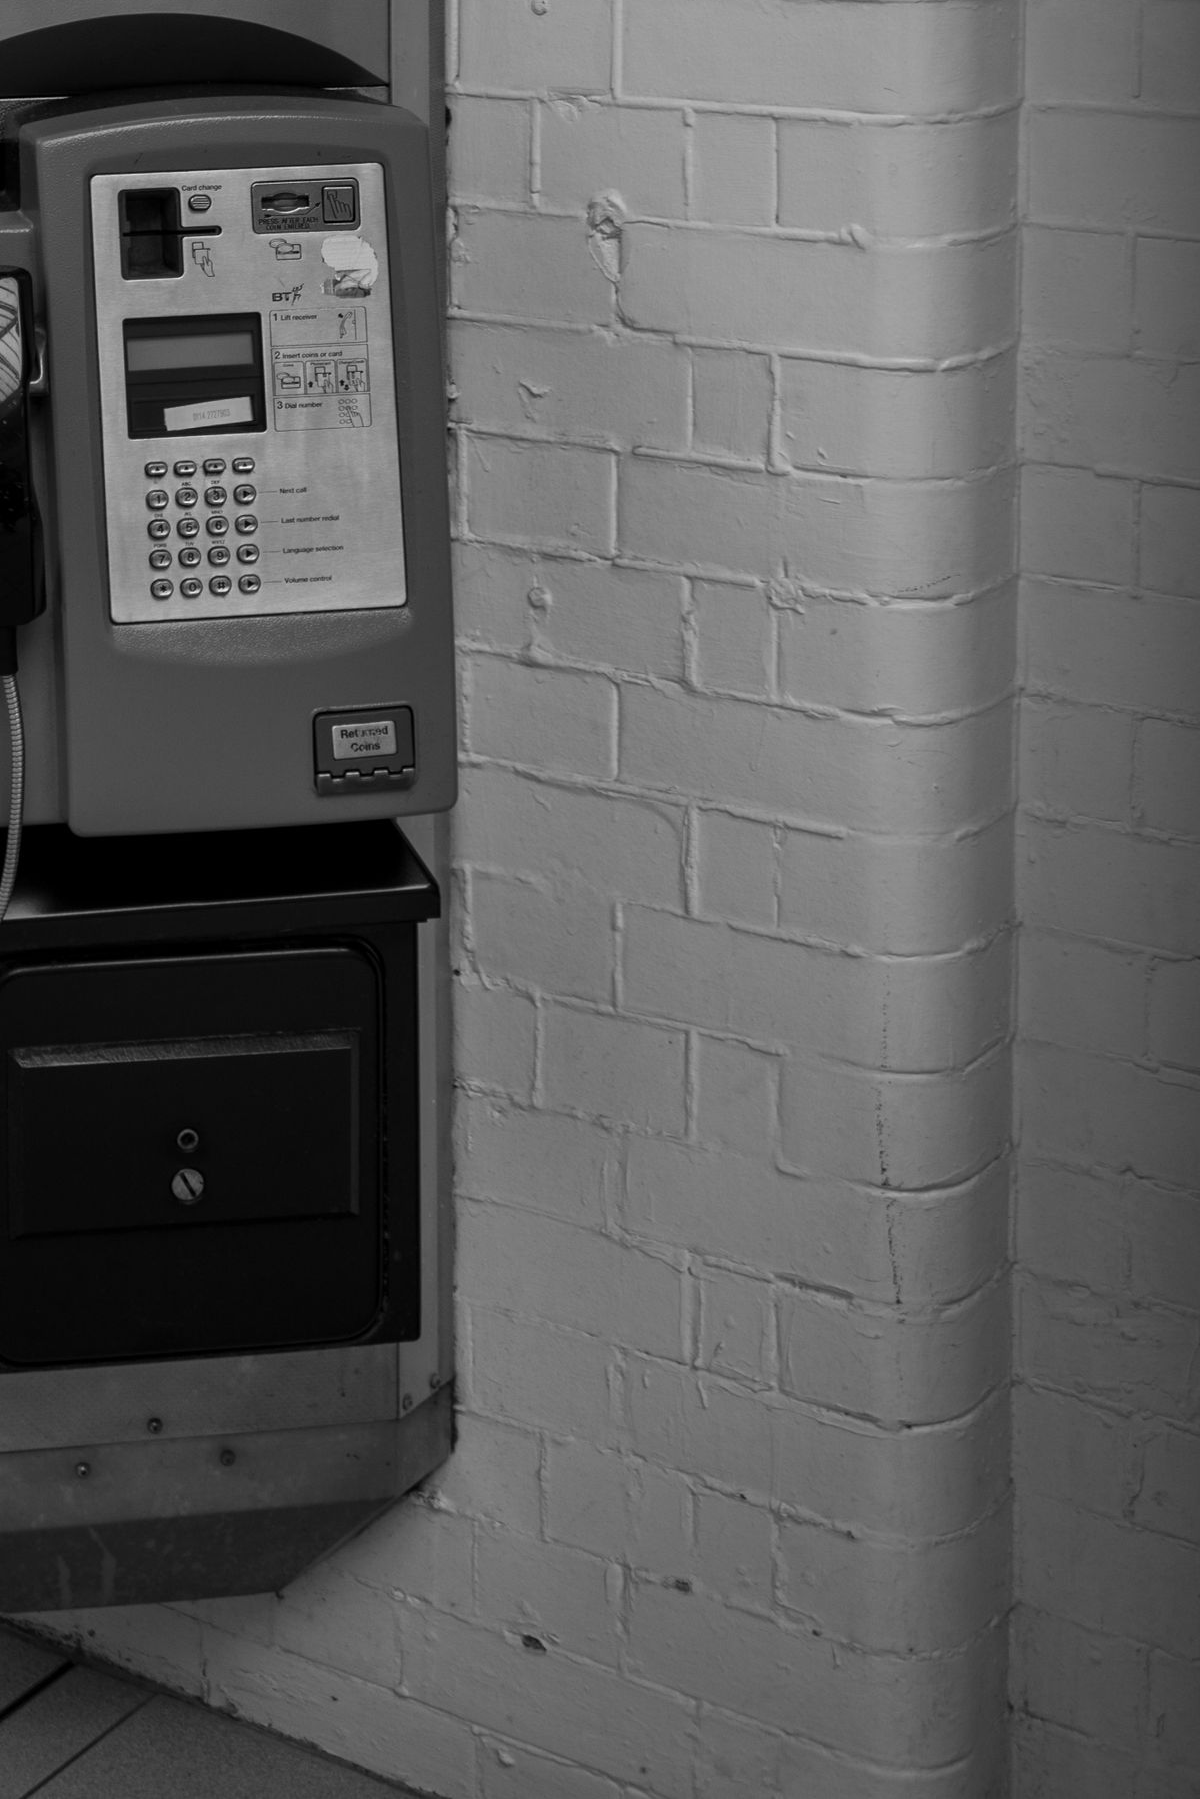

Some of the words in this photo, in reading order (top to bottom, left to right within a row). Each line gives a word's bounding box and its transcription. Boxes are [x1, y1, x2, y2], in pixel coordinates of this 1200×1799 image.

[199, 184, 222, 192] change
[272, 292, 292, 302] BT
[274, 351, 281, 359] 2
[301, 351, 319, 359] coins
[329, 350, 343, 358] card
[277, 401, 284, 409] 3
[282, 547, 314, 555] Language
[315, 545, 344, 553] selection
[350, 743, 381, 752] Coins
